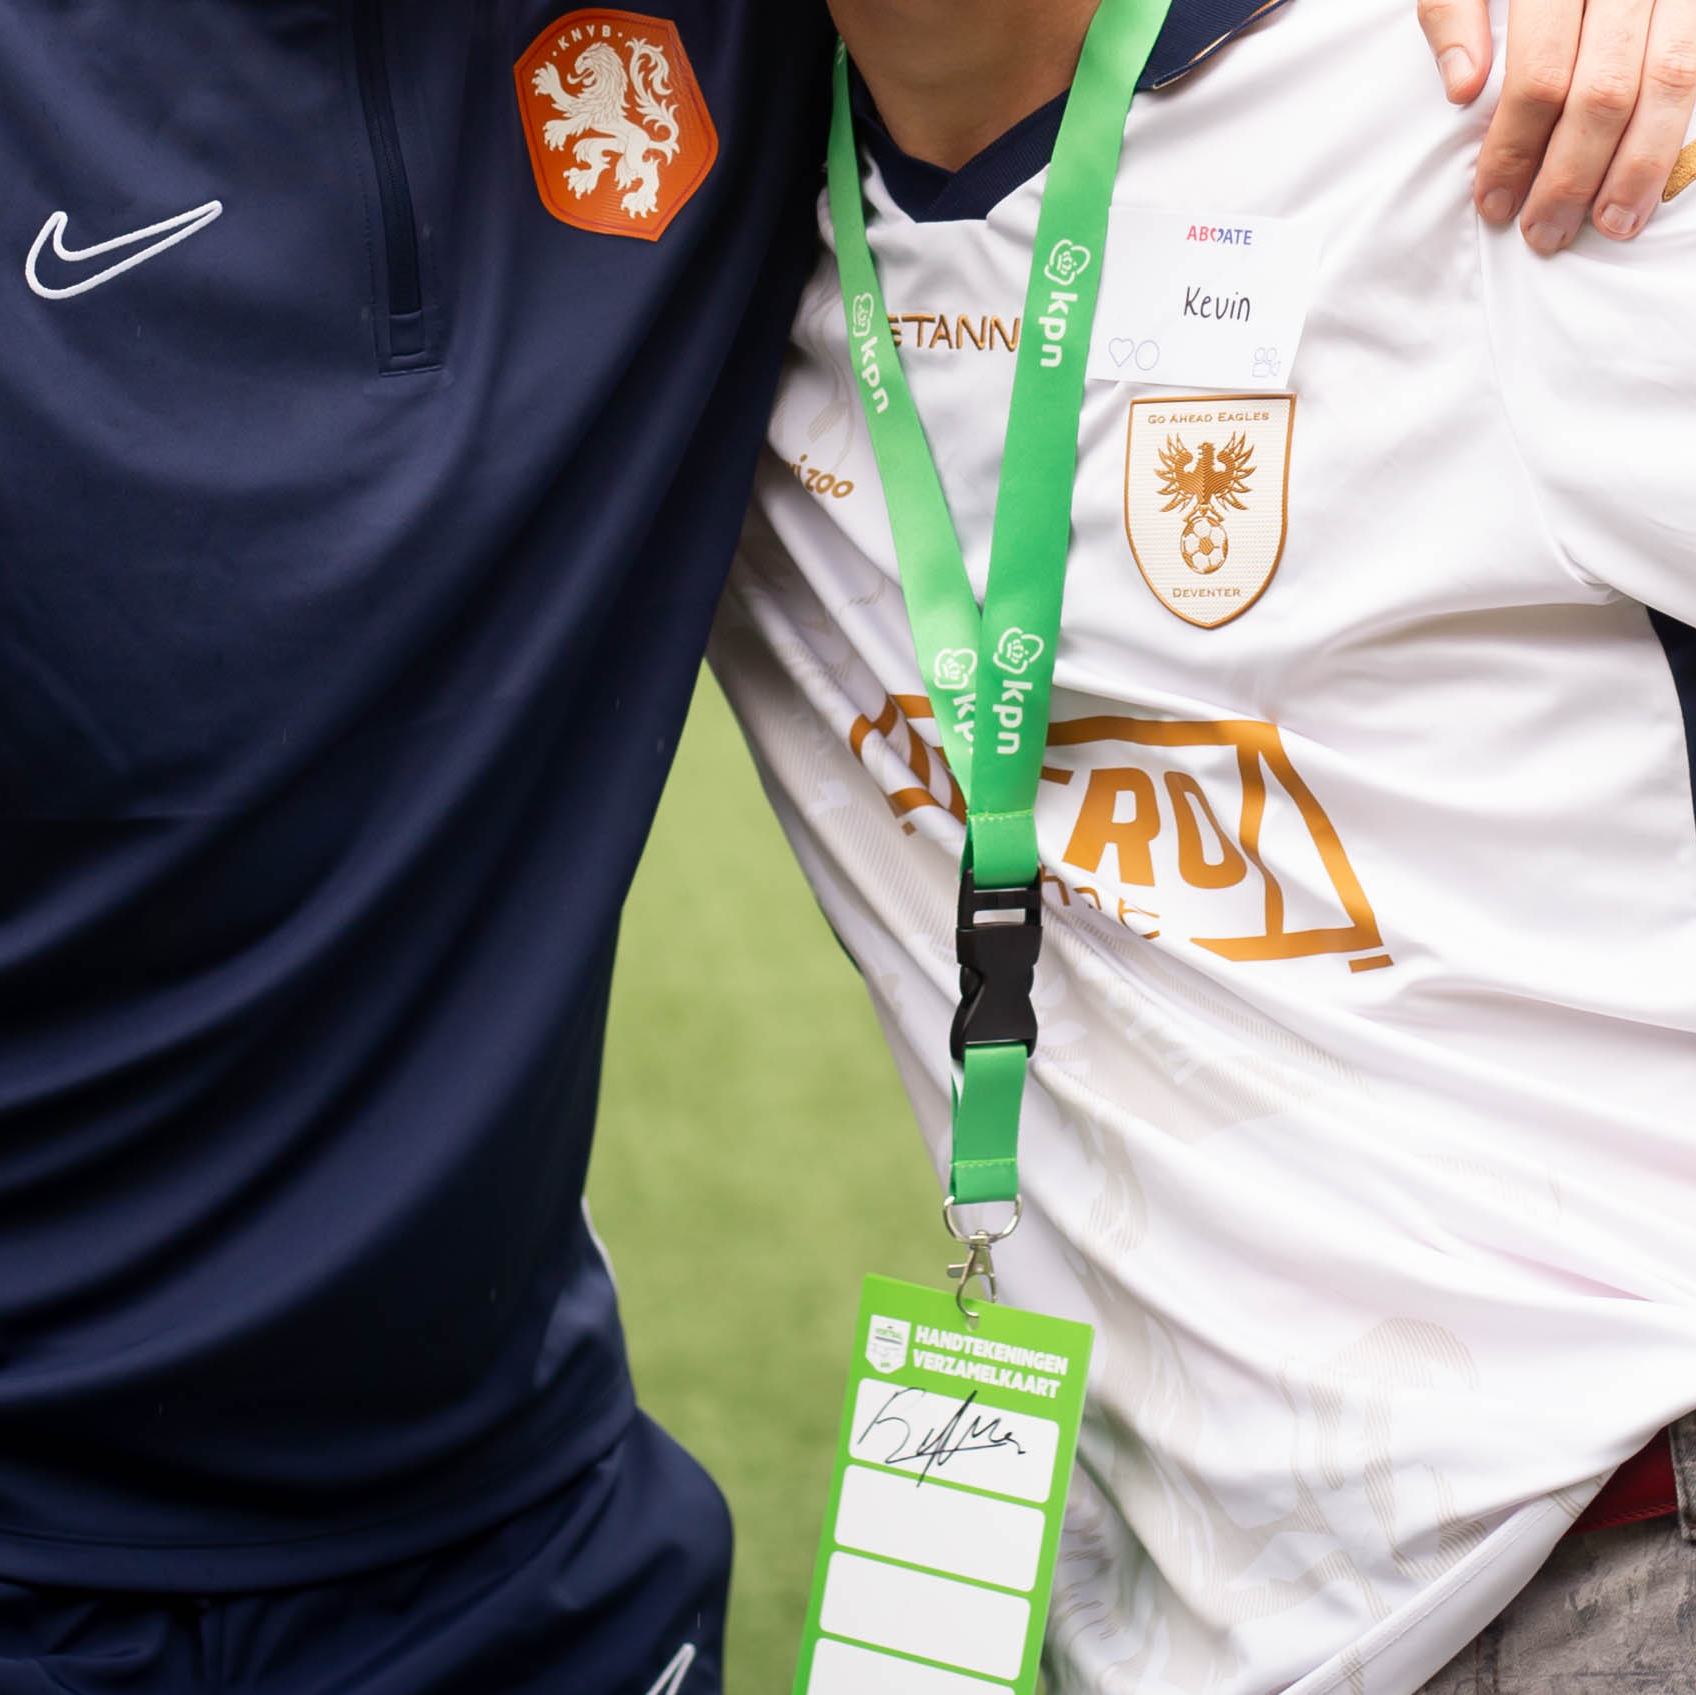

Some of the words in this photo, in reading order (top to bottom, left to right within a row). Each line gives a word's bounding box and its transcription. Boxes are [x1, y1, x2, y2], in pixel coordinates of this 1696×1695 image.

[558, 24, 611, 51] KNVB
[1039, 291, 1078, 367] kpn
[1184, 286, 1250, 322] Kevin
[859, 336, 889, 414] kpn
[953, 692, 977, 756] kp
[993, 679, 1033, 755] kpn
[912, 1349, 1062, 1398] VERZAMELKAART
[914, 1325, 1069, 1376] HANDTEKENINGEN
